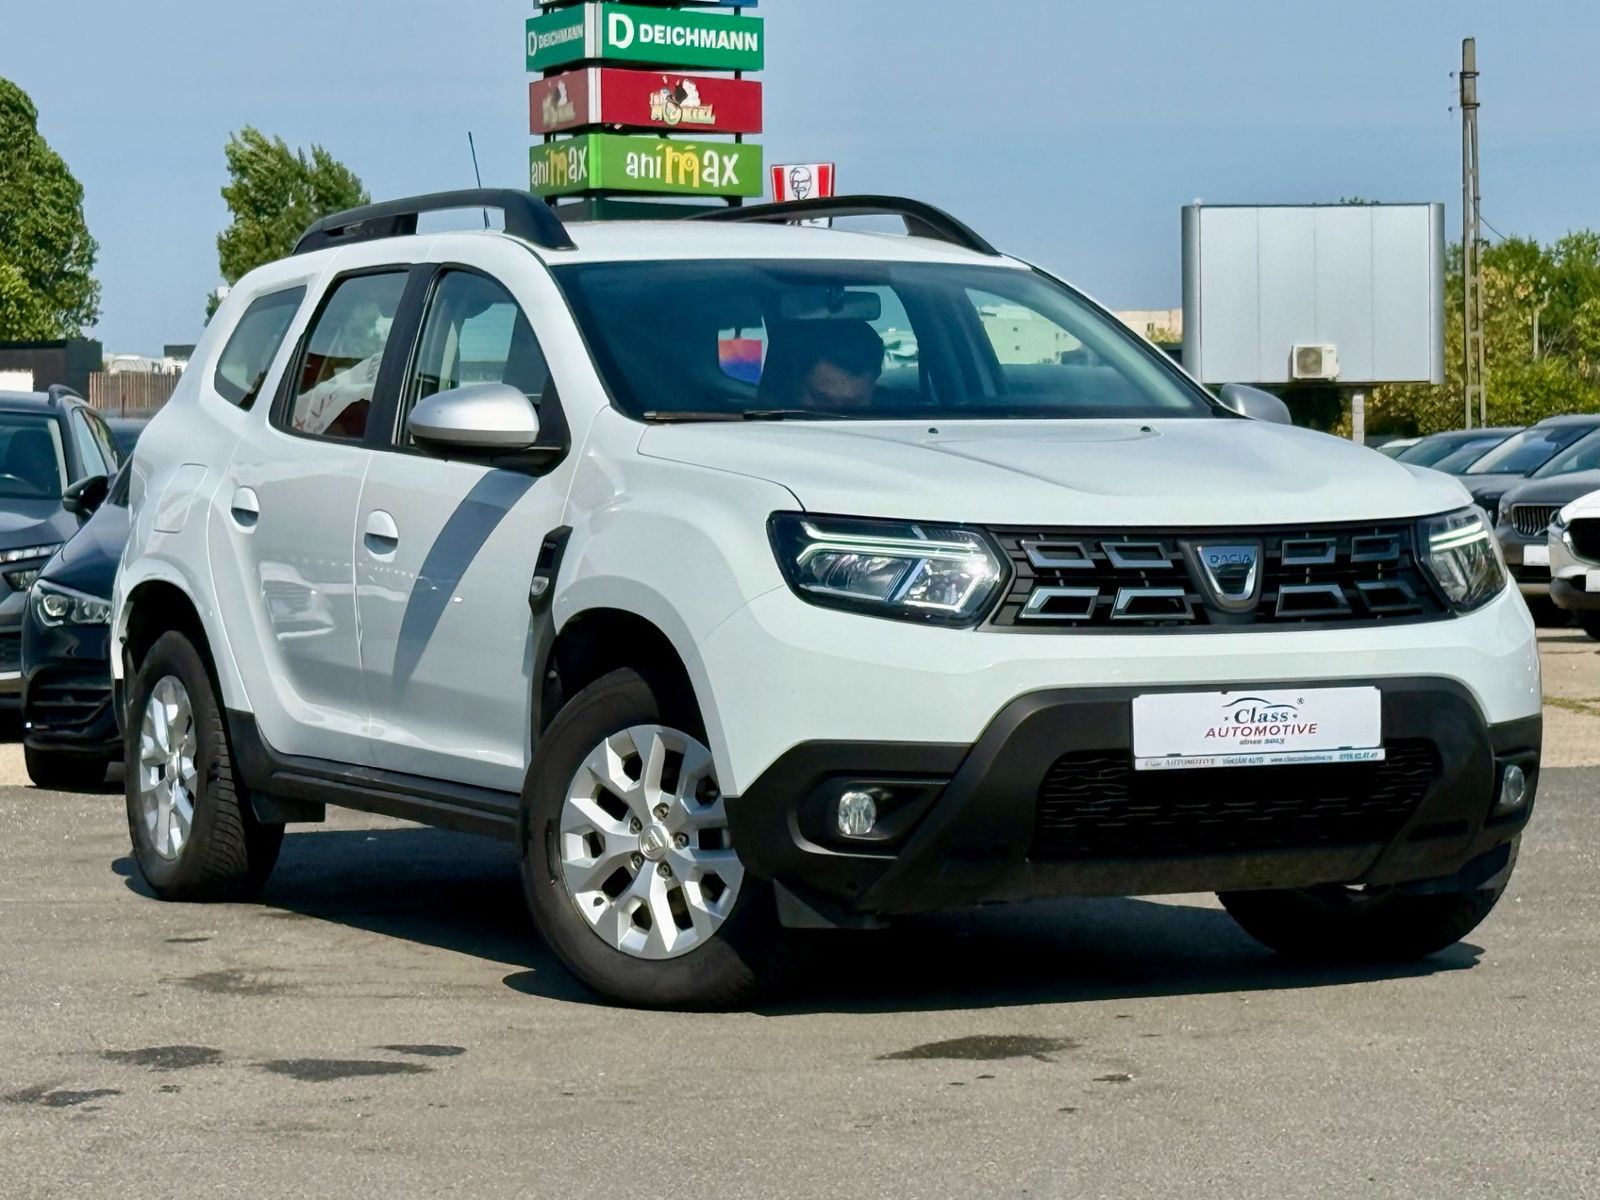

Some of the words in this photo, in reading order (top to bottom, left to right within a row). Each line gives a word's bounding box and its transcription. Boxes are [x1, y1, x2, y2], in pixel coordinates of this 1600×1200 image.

[528, 31, 538, 56] D
[538, 24, 584, 48] DEICHMANN
[608, 13, 634, 49] D
[639, 23, 758, 51] DEICHMANN
[532, 145, 588, 187] animax
[626, 144, 739, 188] animax
[1210, 553, 1252, 564] DACIA
[1234, 706, 1289, 724] Class
[1204, 723, 1318, 739] AUTOMOTIVE
[1239, 738, 1262, 746] since
[1166, 757, 1216, 768] AUTOMOTIVE
